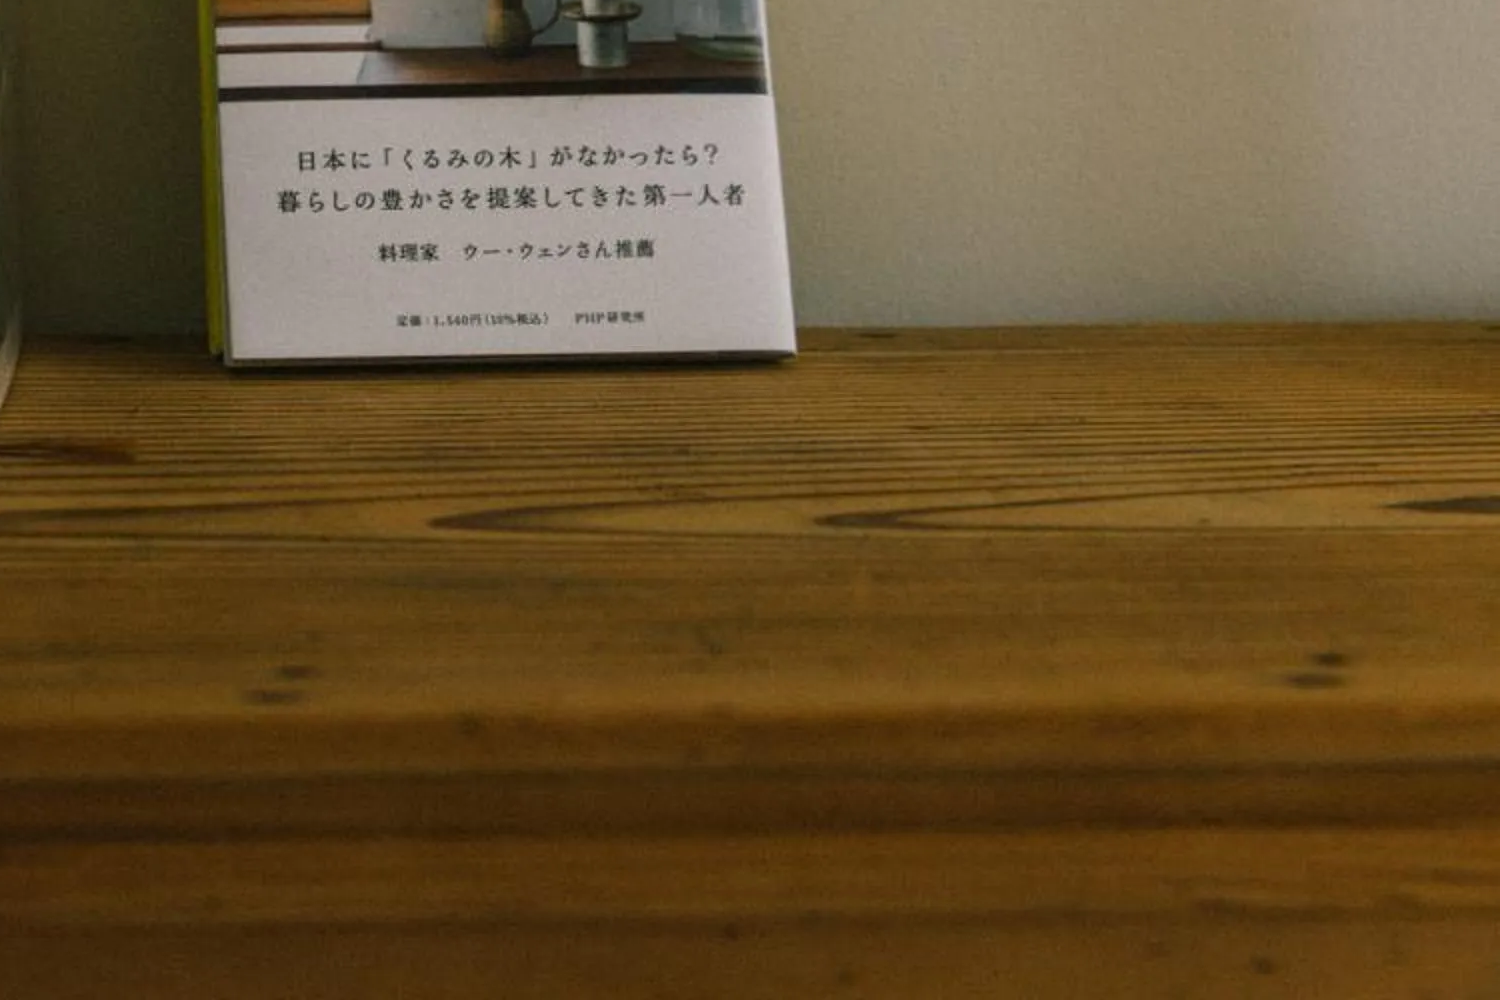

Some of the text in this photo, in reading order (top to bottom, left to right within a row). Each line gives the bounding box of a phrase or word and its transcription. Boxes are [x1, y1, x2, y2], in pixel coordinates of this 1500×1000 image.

[280, 183, 746, 213] 暮らしの豊かさを提案してきた第一人者
[377, 238, 655, 262] 料理家 ウー・ウェンさん推薦
